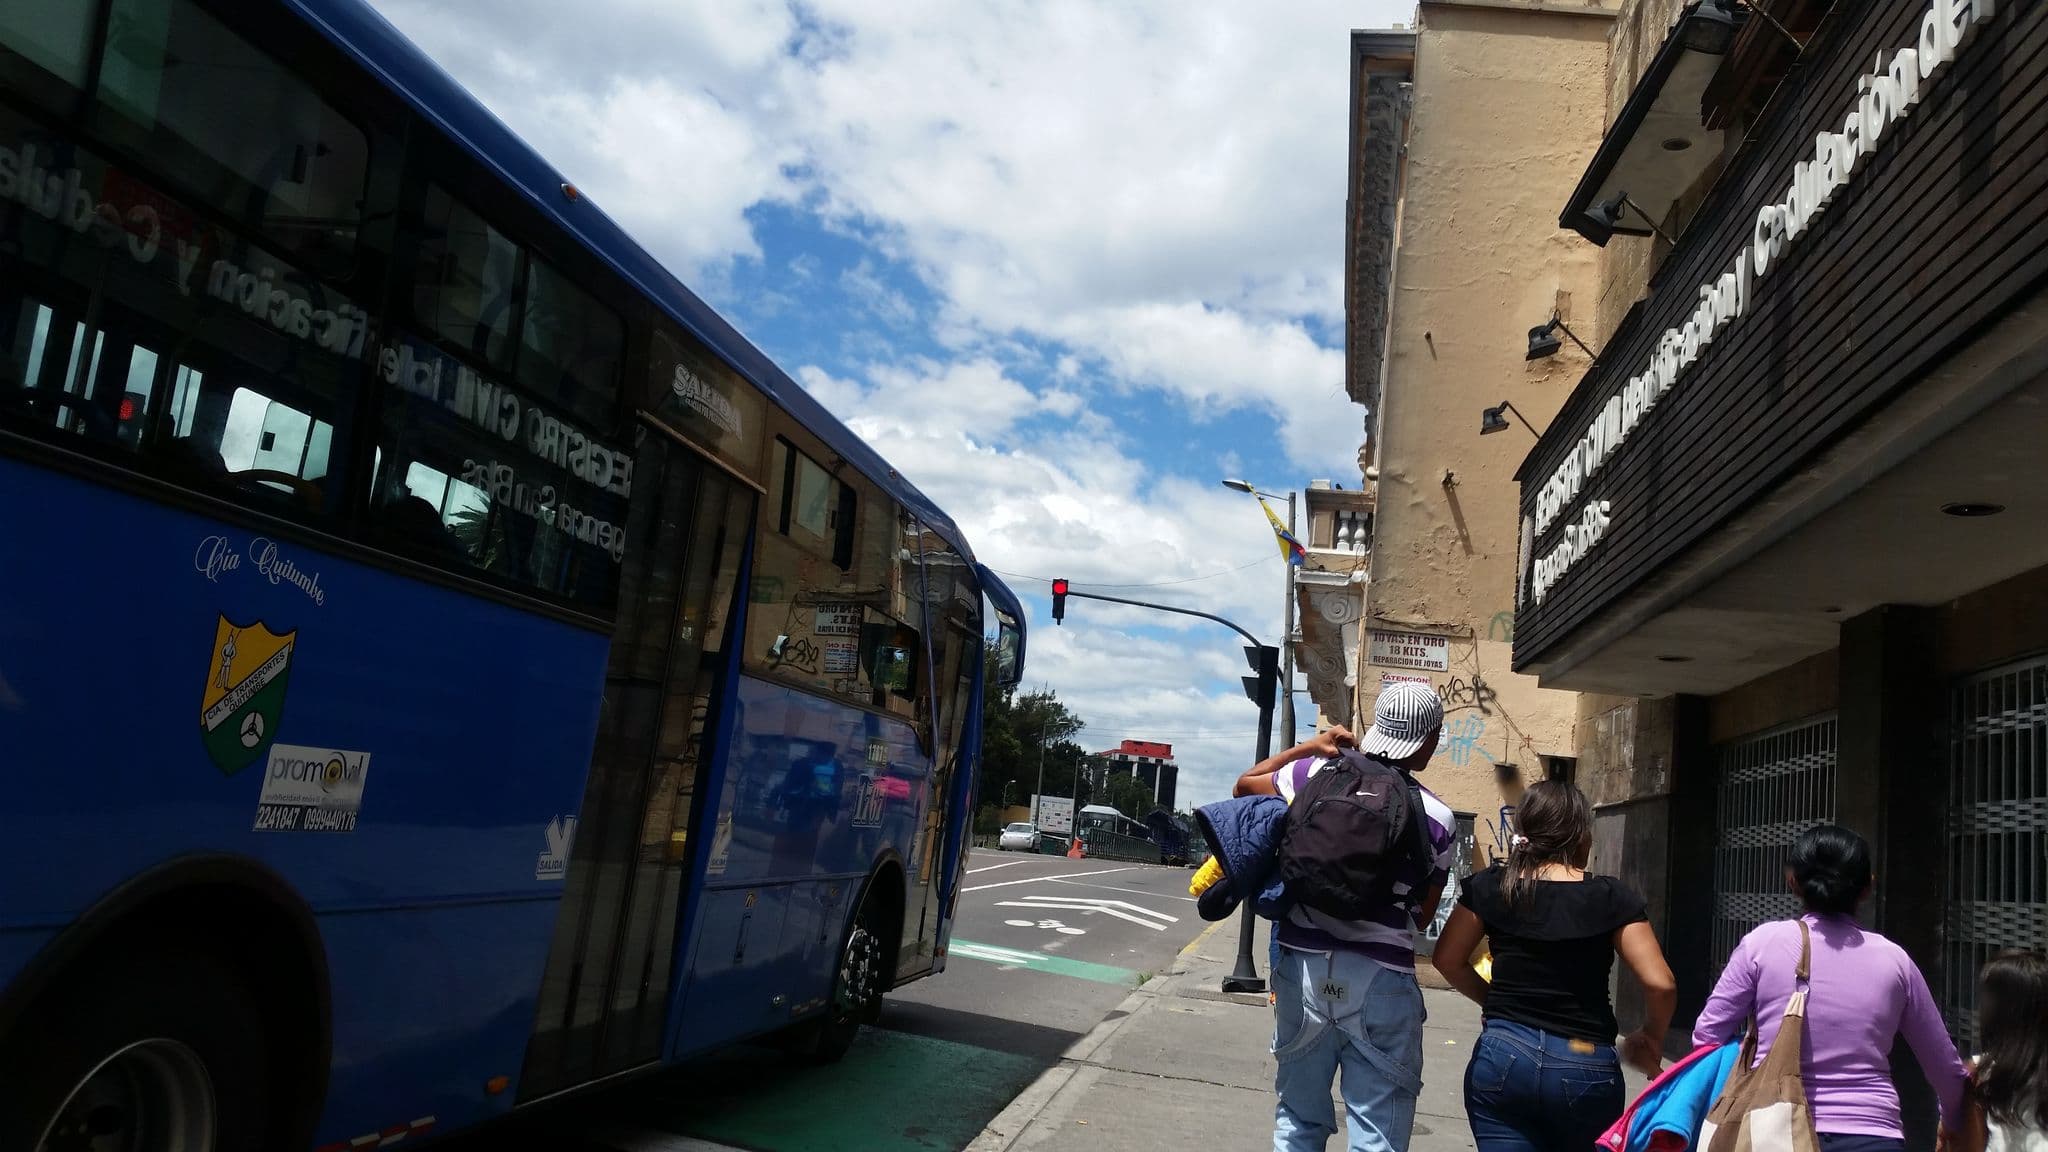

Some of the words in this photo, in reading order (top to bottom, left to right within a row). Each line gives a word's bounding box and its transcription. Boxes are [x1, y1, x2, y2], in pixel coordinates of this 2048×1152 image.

[1585, 396, 1624, 478] CIVIL
[1735, 246, 1756, 319] y
[1754, 48, 1919, 277] Cedulación
[1918, 0, 1996, 79] de
[1374, 632, 1405, 645] JOYAS
[1407, 635, 1421, 646] EN
[1423, 636, 1446, 648] ORO
[1389, 645, 1401, 655] 18
[1403, 646, 1429, 658] KLTS.
[1414, 659, 1422, 667] DE
[1423, 660, 1443, 669] JOYAS
[223, 695, 236, 707] DE
[235, 651, 286, 697] TRANSPORTES
[229, 677, 266, 712] QUITUMBE
[256, 805, 301, 830] 2241847
